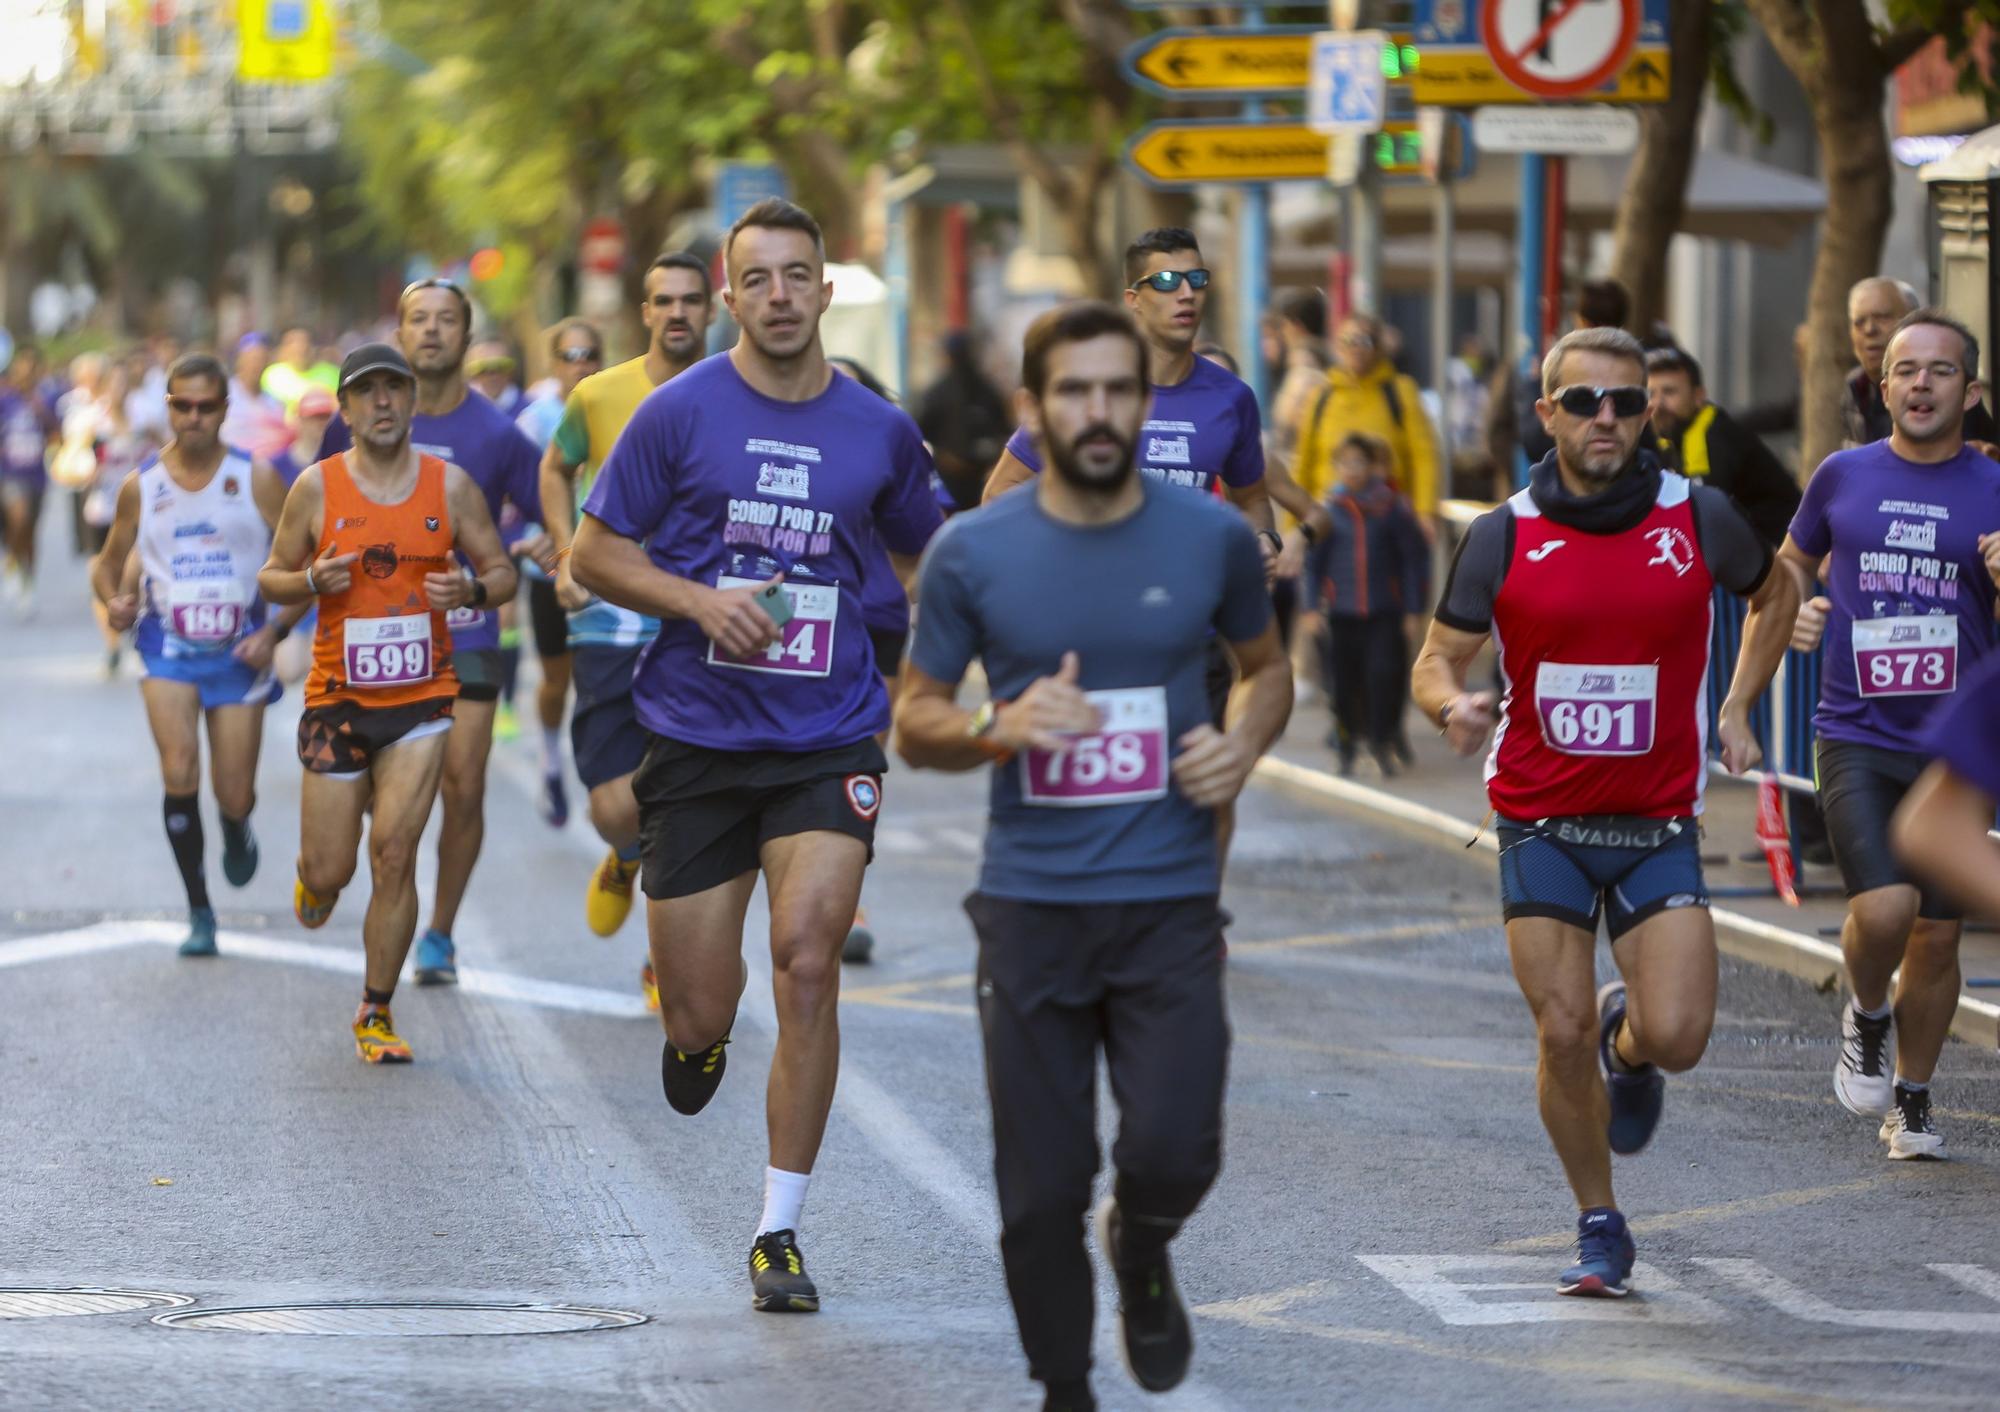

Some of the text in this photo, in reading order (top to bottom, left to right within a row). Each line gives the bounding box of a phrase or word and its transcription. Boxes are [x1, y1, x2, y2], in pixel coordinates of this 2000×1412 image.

[728, 499, 834, 533] CORRO POR TI
[723, 521, 831, 555] CORRO POR MI
[1860, 552, 1959, 581] CORRO POR TI
[1859, 572, 1958, 600] CORRO POR MI
[356, 642, 425, 678] 599
[1870, 653, 1945, 688] 873
[1550, 701, 1635, 746] 691
[1045, 732, 1147, 786] 758
[1558, 822, 1662, 848] EVADICT
